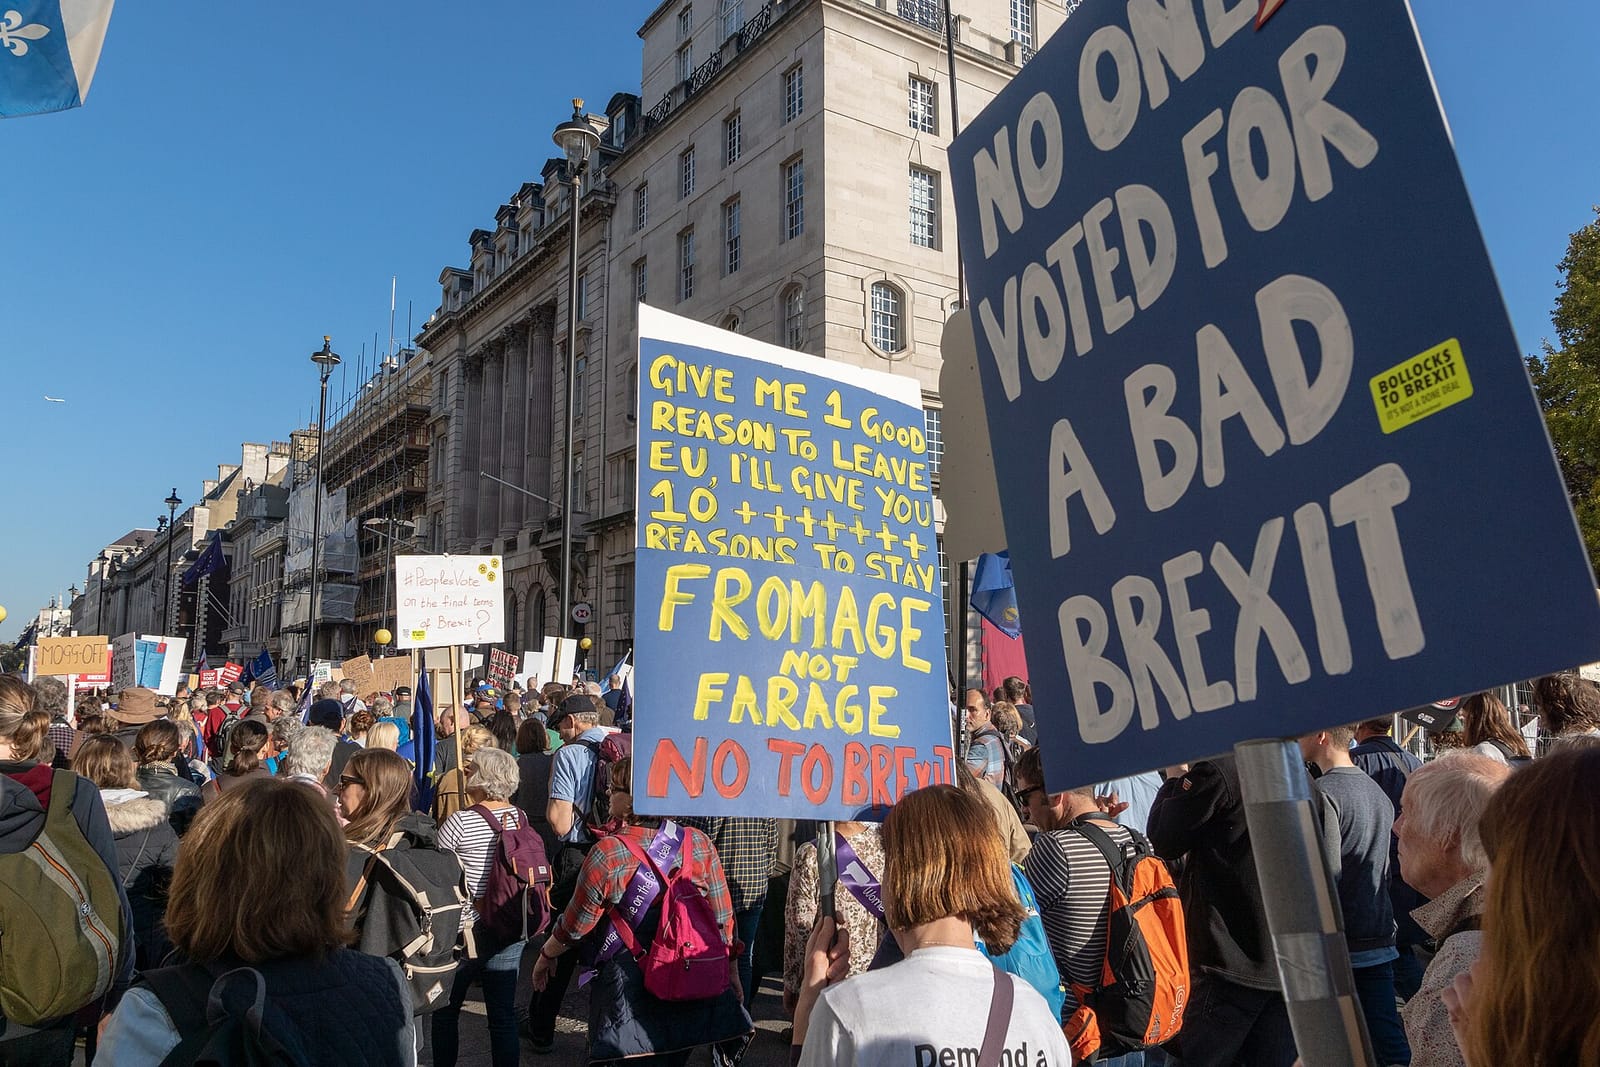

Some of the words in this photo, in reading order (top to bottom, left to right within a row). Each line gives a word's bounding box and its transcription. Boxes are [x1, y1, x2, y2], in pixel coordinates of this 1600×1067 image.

[973, 92, 1063, 259] NO
[978, 184, 1177, 402] VOTED
[1181, 25, 1379, 269] FOR
[649, 354, 736, 403] GIVE
[755, 376, 808, 418] ME
[824, 390, 852, 429] 1
[860, 407, 926, 454] GOOD
[1378, 348, 1451, 394] BOLLOCKS
[1381, 391, 1399, 408] TO
[1404, 362, 1456, 398] BREXIT
[1399, 401, 1414, 414] NOT
[1441, 380, 1460, 395] DEAL
[651, 401, 776, 452] REASON
[780, 429, 818, 461] TO
[832, 440, 929, 492] LEAVE
[1049, 418, 1116, 559] A
[1124, 274, 1354, 512] BAD
[650, 479, 718, 523] 10
[730, 453, 783, 493] I'LL
[791, 466, 866, 511] GIVE
[874, 485, 931, 527] YOU
[646, 523, 798, 564] REASONS
[812, 543, 855, 575] TO
[864, 552, 935, 593] STAY
[404, 598, 416, 607] on
[420, 597, 438, 608] the
[442, 595, 467, 607] final
[473, 598, 494, 607] terms
[420, 618, 431, 631] of
[437, 615, 472, 629] Brexit
[658, 563, 932, 674] FROMAGE
[1057, 462, 1426, 744] BREXIT
[490, 664, 514, 679] PROUD
[491, 649, 518, 666] HITLER
[779, 650, 859, 683] NOT
[693, 672, 901, 738] FARAGE
[647, 736, 750, 799] NO
[766, 738, 834, 806] TO
[914, 1041, 1027, 1067] Demnd
